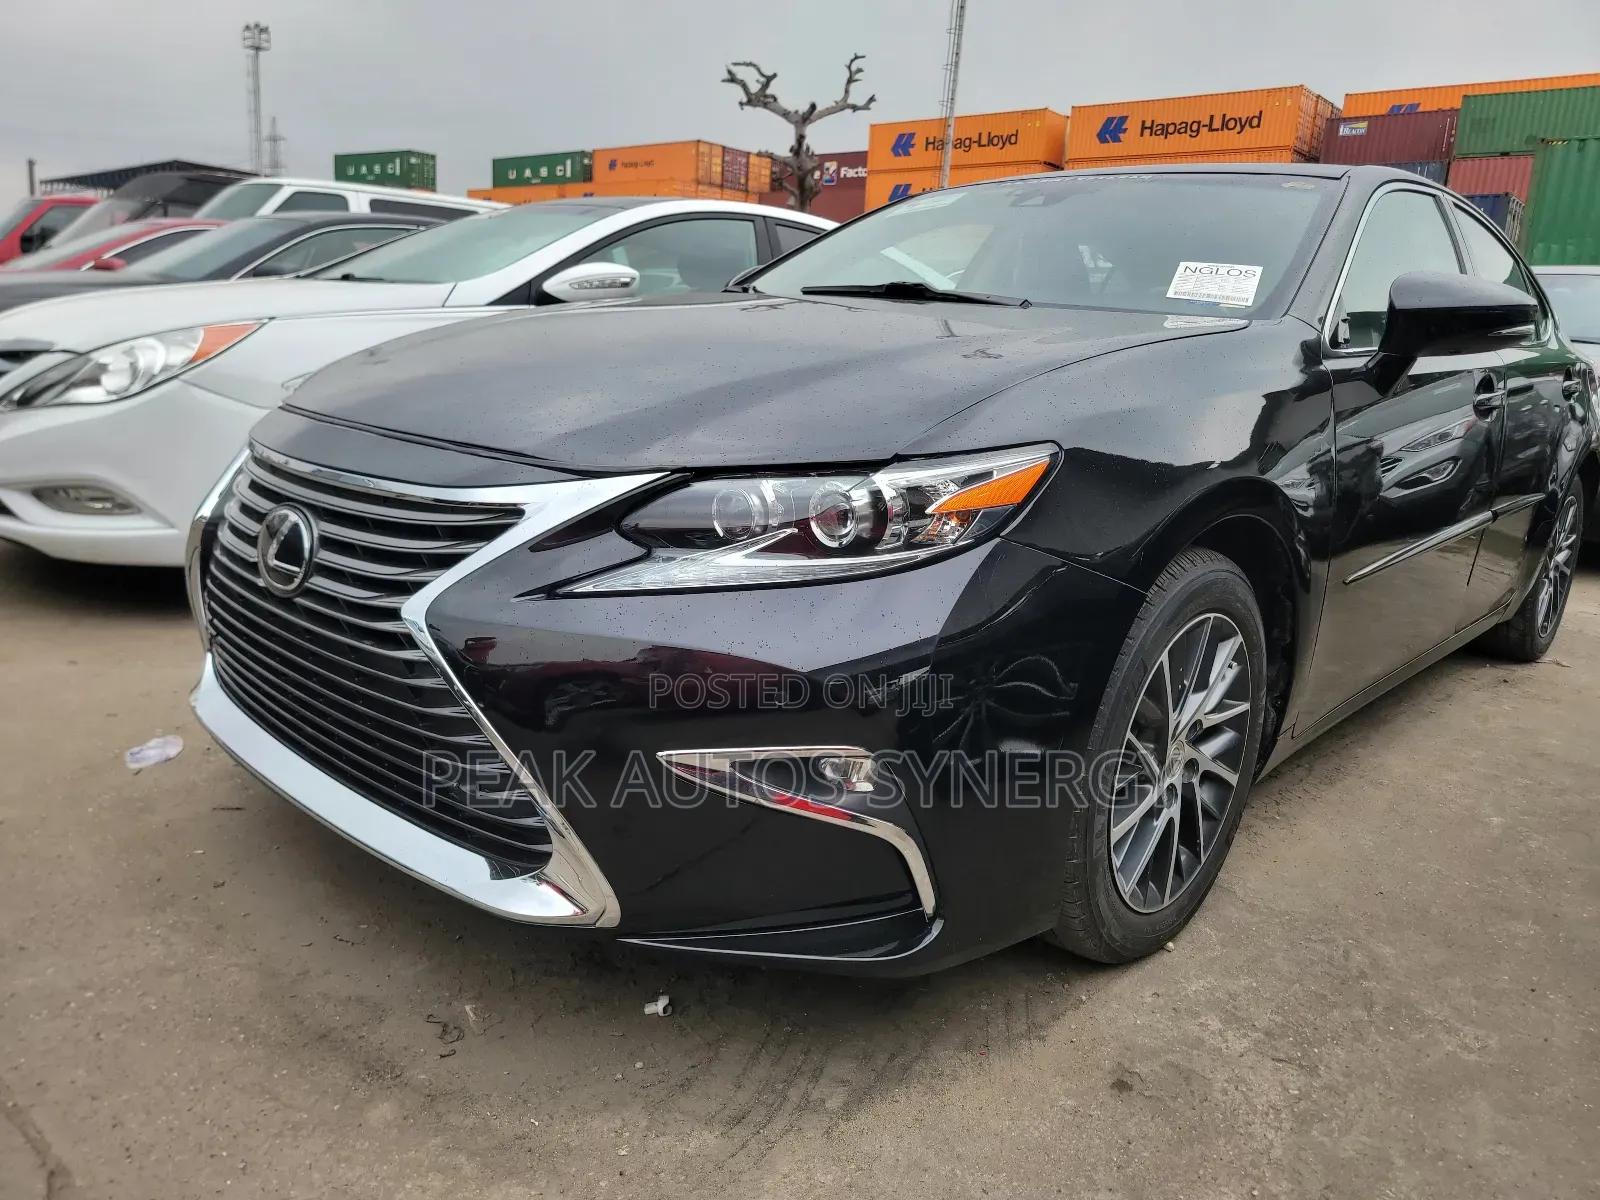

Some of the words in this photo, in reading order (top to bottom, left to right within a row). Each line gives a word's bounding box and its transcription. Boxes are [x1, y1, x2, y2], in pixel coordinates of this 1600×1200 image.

[1139, 110, 1263, 139] Hapag-Lloyd
[925, 129, 1019, 153] Haag-Lloyd
[1183, 265, 1257, 279] NGLOS
